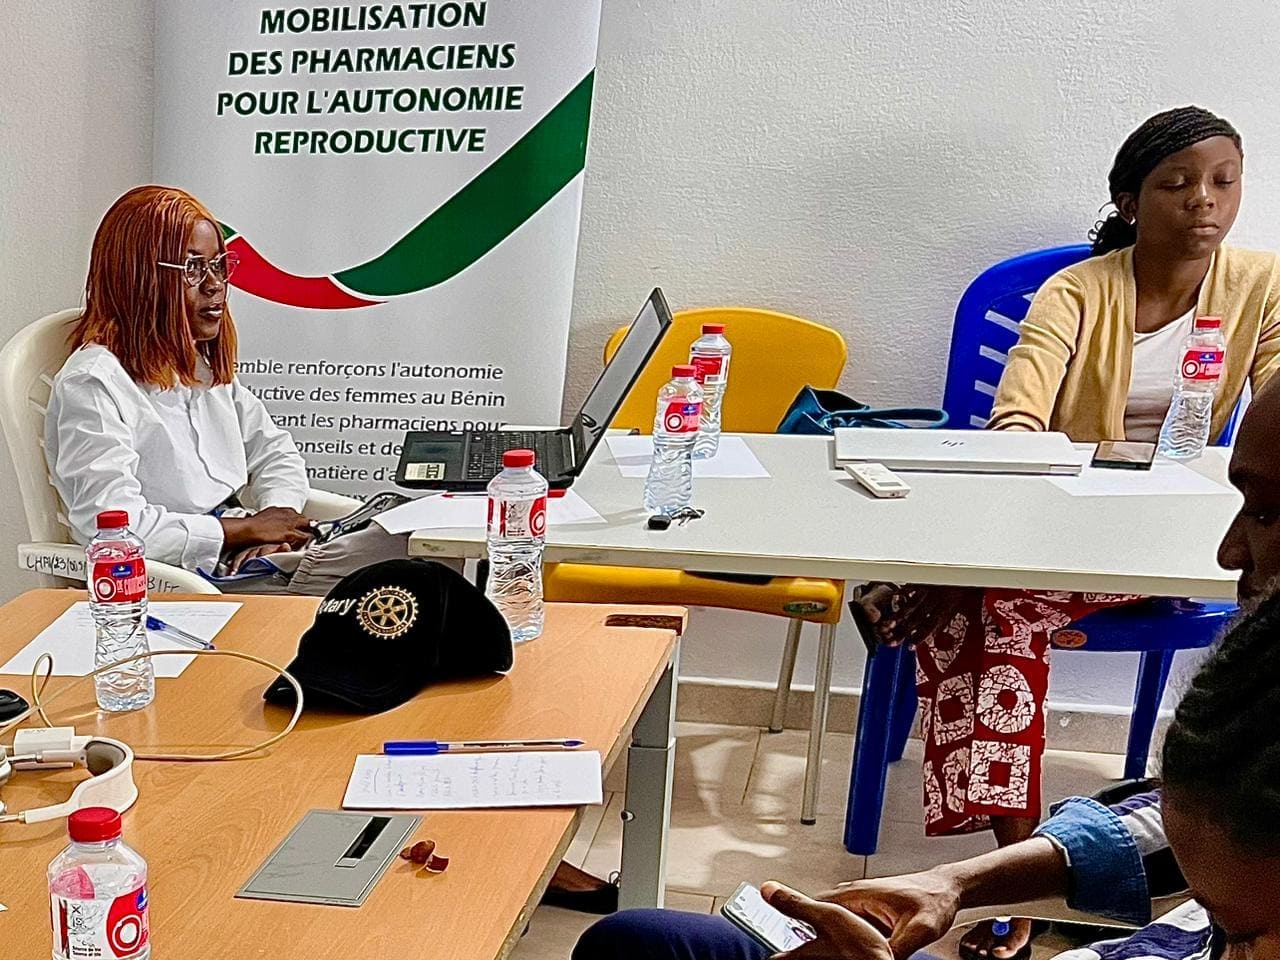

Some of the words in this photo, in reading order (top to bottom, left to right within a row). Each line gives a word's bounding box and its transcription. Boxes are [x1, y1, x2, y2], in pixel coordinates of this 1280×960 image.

[260, 2, 486, 34] MOBILISATION
[227, 51, 282, 76] DES
[291, 43, 516, 75] PHARMACIENS
[218, 91, 298, 115] POUR
[307, 86, 523, 114] L'AUTONOMIE
[255, 128, 486, 154] REPRODUCTIVE
[288, 361, 386, 379] renforçons
[391, 362, 504, 380] l'autonomie
[310, 387, 340, 401] des
[345, 388, 417, 403] femmes
[421, 392, 445, 405] au
[451, 390, 505, 407] Bénin
[311, 413, 335, 428] les
[339, 414, 457, 433] pharmaciens
[358, 443, 376, 455] et
